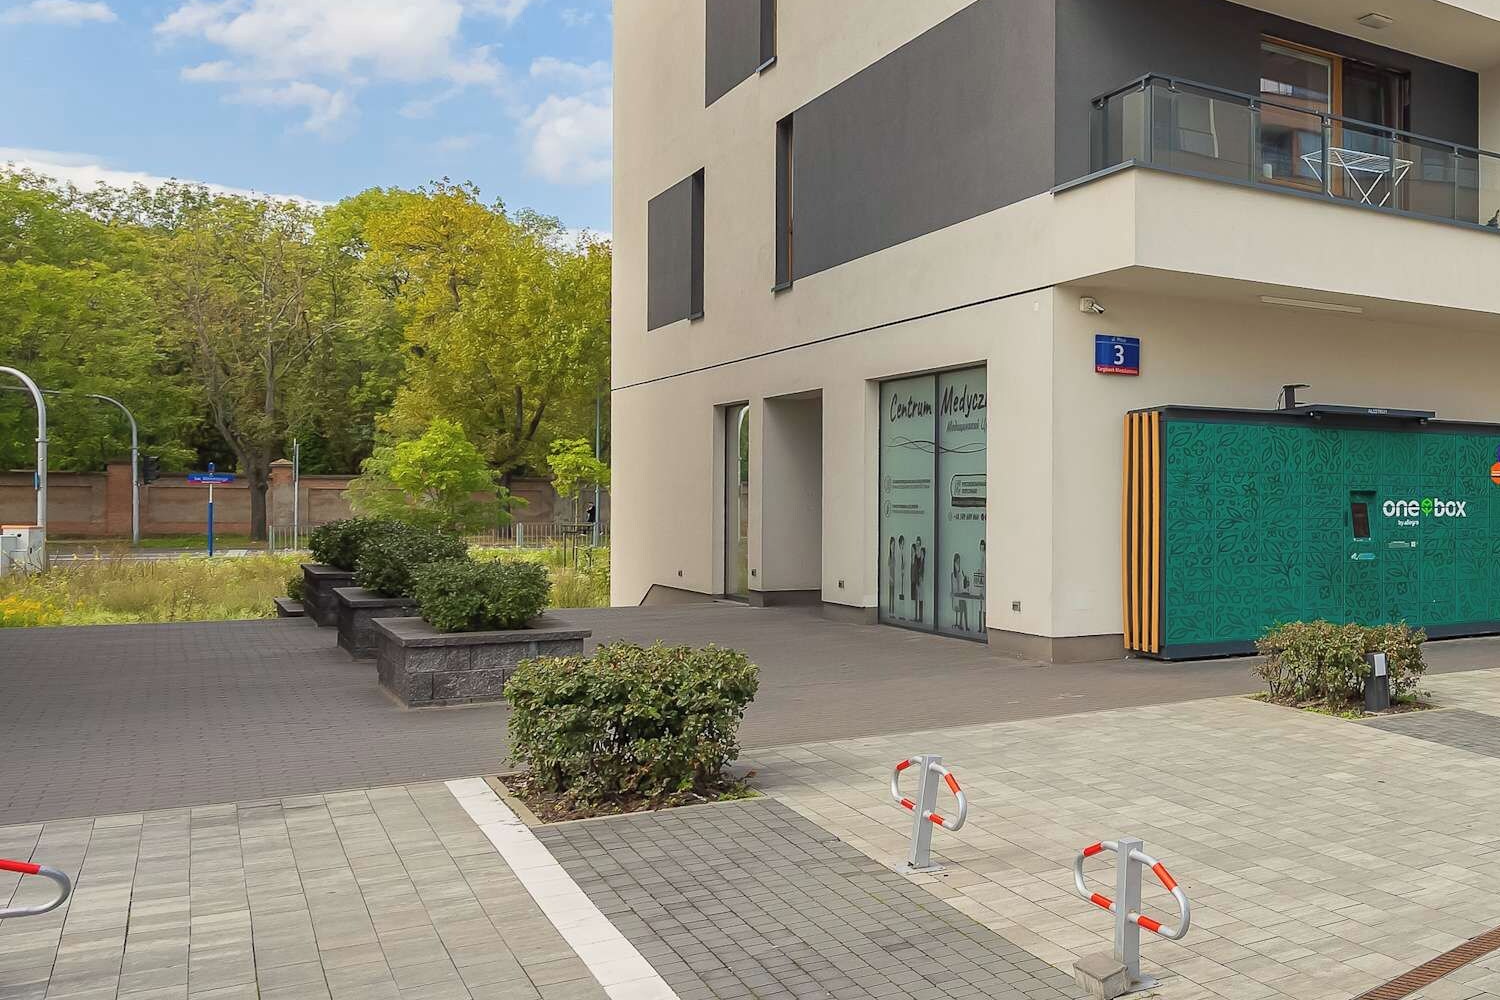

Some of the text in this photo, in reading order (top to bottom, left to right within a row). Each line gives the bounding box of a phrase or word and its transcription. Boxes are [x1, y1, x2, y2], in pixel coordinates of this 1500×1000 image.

[1113, 344, 1125, 366] 3
[889, 384, 987, 422] Centrum Medycz
[1382, 498, 1467, 518] one box
